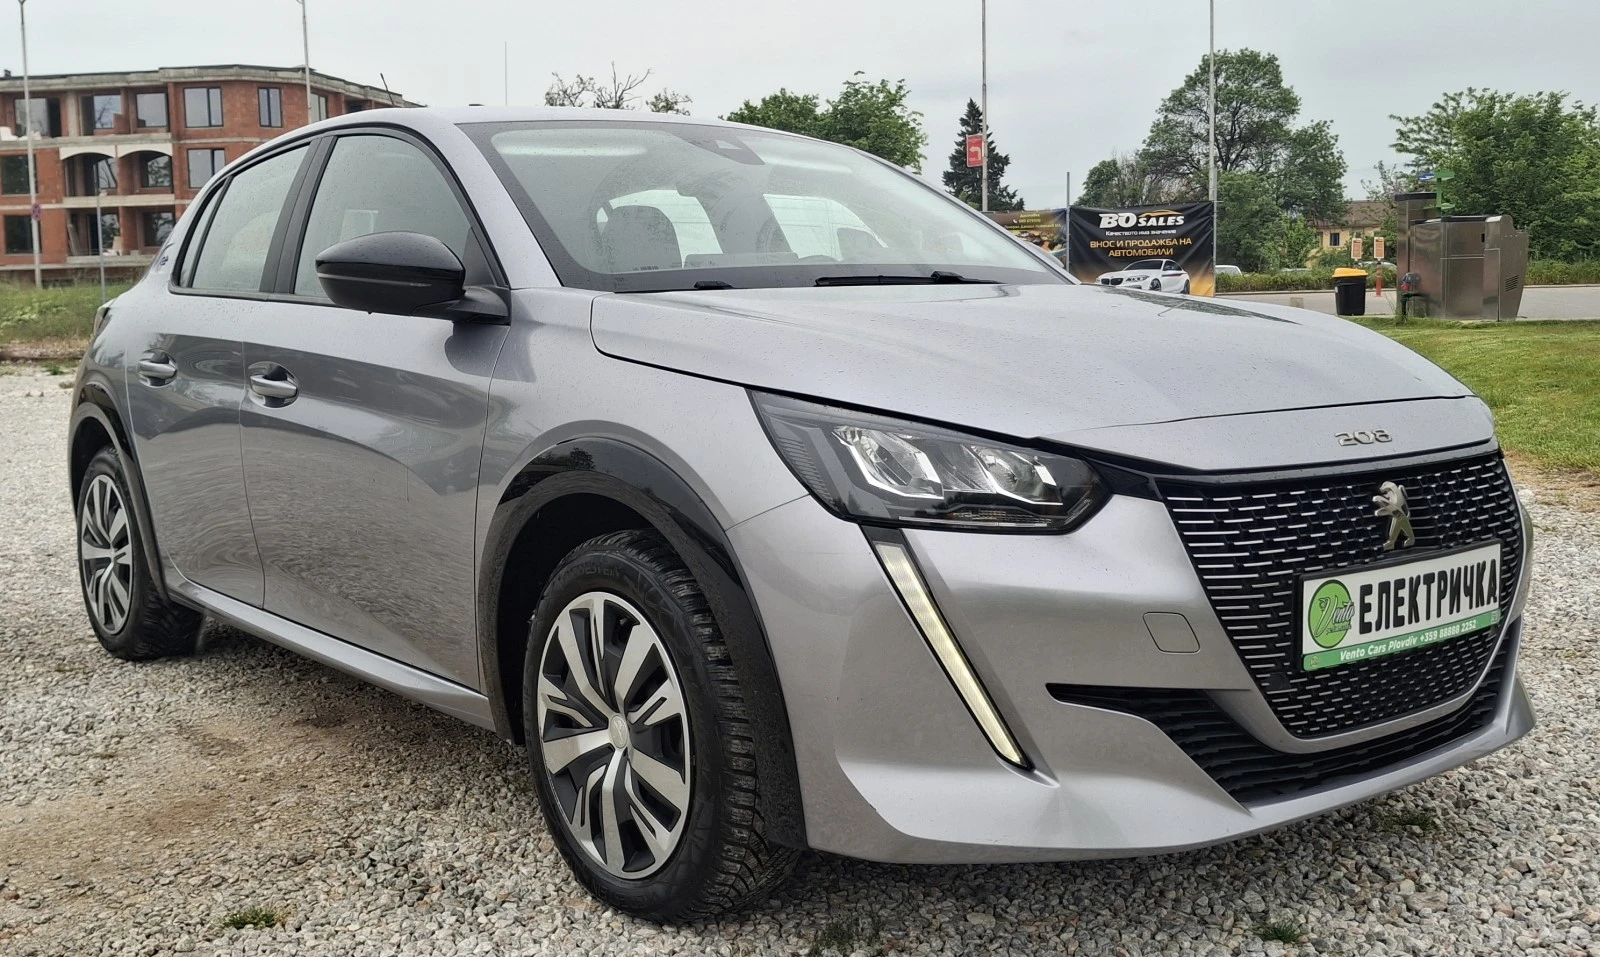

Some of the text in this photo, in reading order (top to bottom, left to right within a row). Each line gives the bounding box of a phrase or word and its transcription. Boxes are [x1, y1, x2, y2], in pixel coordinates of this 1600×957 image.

[1098, 212, 1185, 229] BO SALES
[1090, 237, 1193, 249] ВНОС И ПРОДАЖБА НА
[1108, 248, 1174, 257] АВТОМОБИЛИ
[1335, 429, 1393, 447] 208
[1359, 558, 1498, 635] ЕЛЕКТРИЧКА
[1340, 619, 1477, 661] Vento Cars Plovdiv +359 88888 2252
